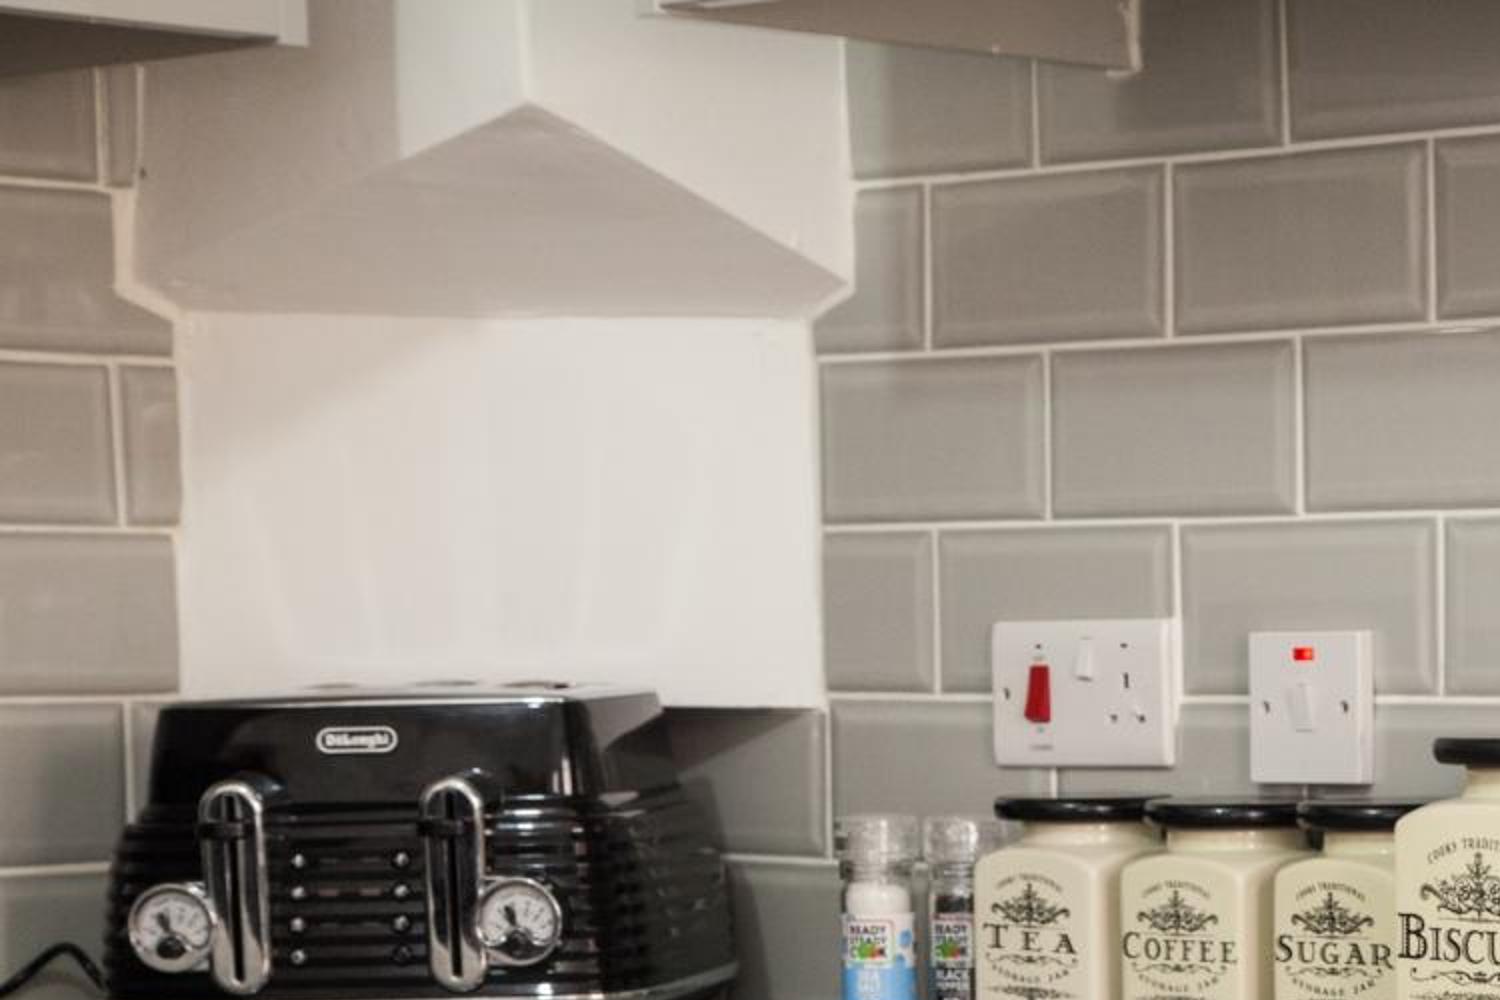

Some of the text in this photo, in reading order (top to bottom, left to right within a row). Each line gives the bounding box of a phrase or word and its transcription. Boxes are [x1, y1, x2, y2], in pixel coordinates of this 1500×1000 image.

[983, 922, 1077, 954] TEA
[1122, 930, 1240, 964] COFFEE
[1275, 934, 1394, 970] SUGAR
